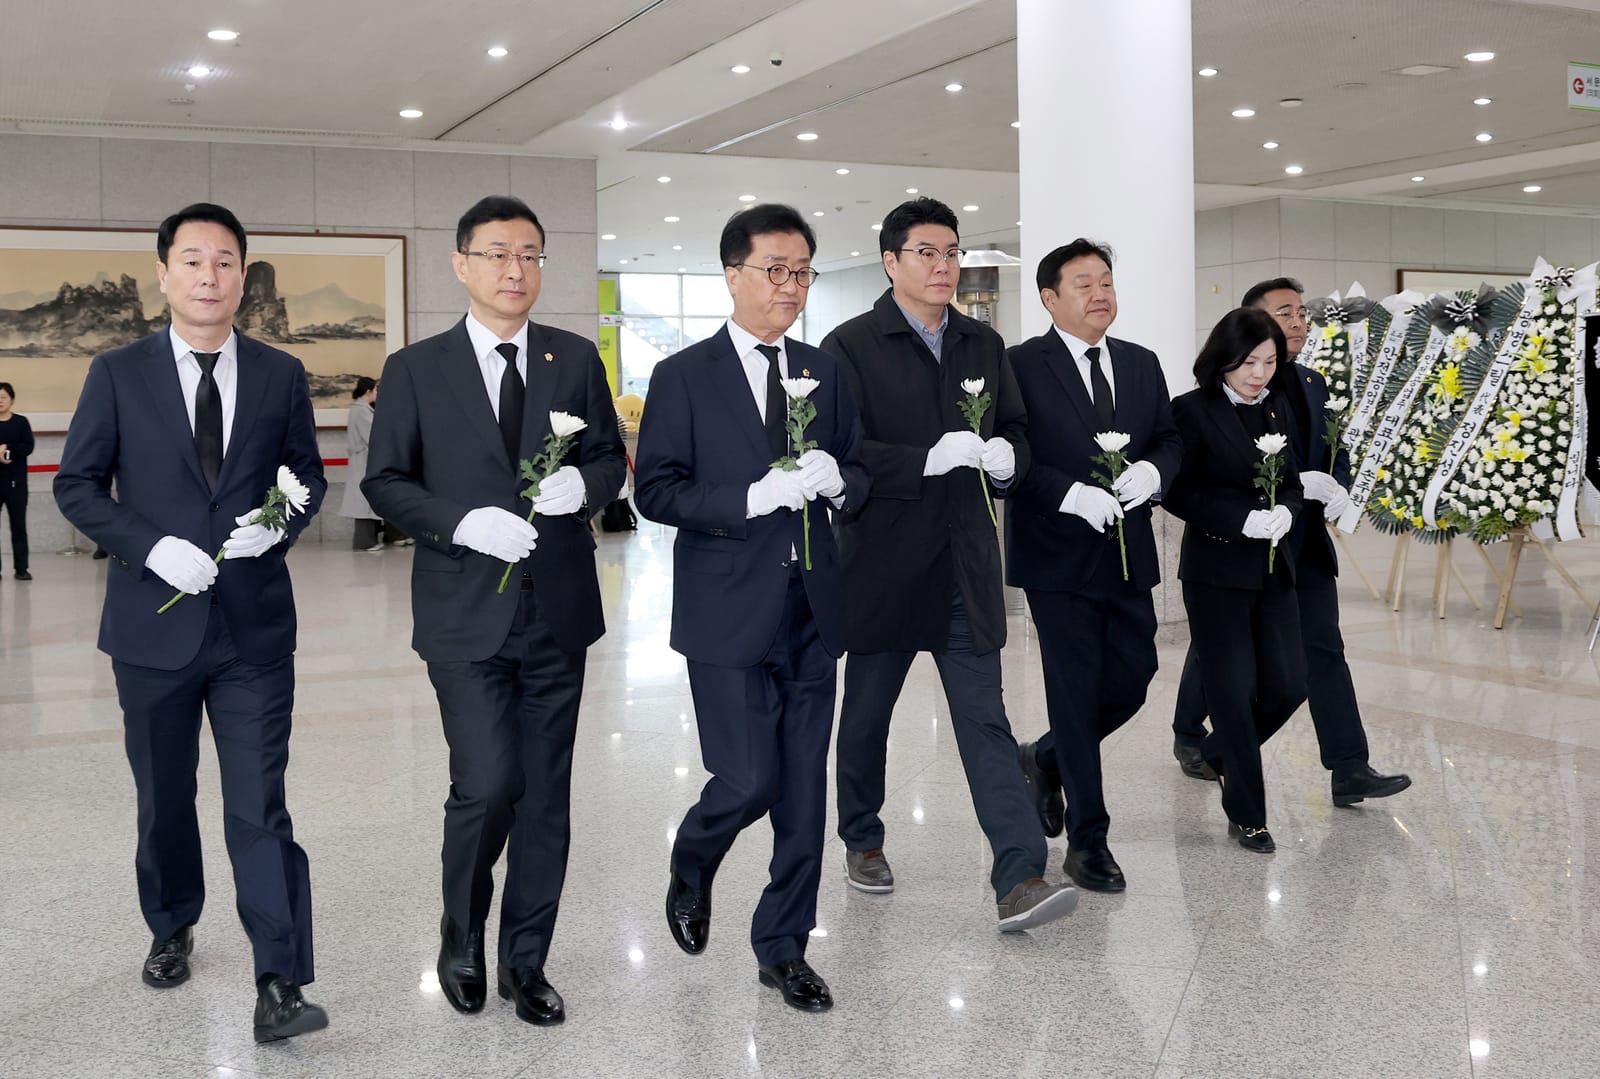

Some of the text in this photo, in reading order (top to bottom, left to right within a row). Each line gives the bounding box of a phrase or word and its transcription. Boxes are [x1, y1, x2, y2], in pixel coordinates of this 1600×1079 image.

[1366, 415, 1401, 465] 대표이사
[1440, 421, 1477, 477] 정진성
[1350, 469, 1376, 508] 손주환
